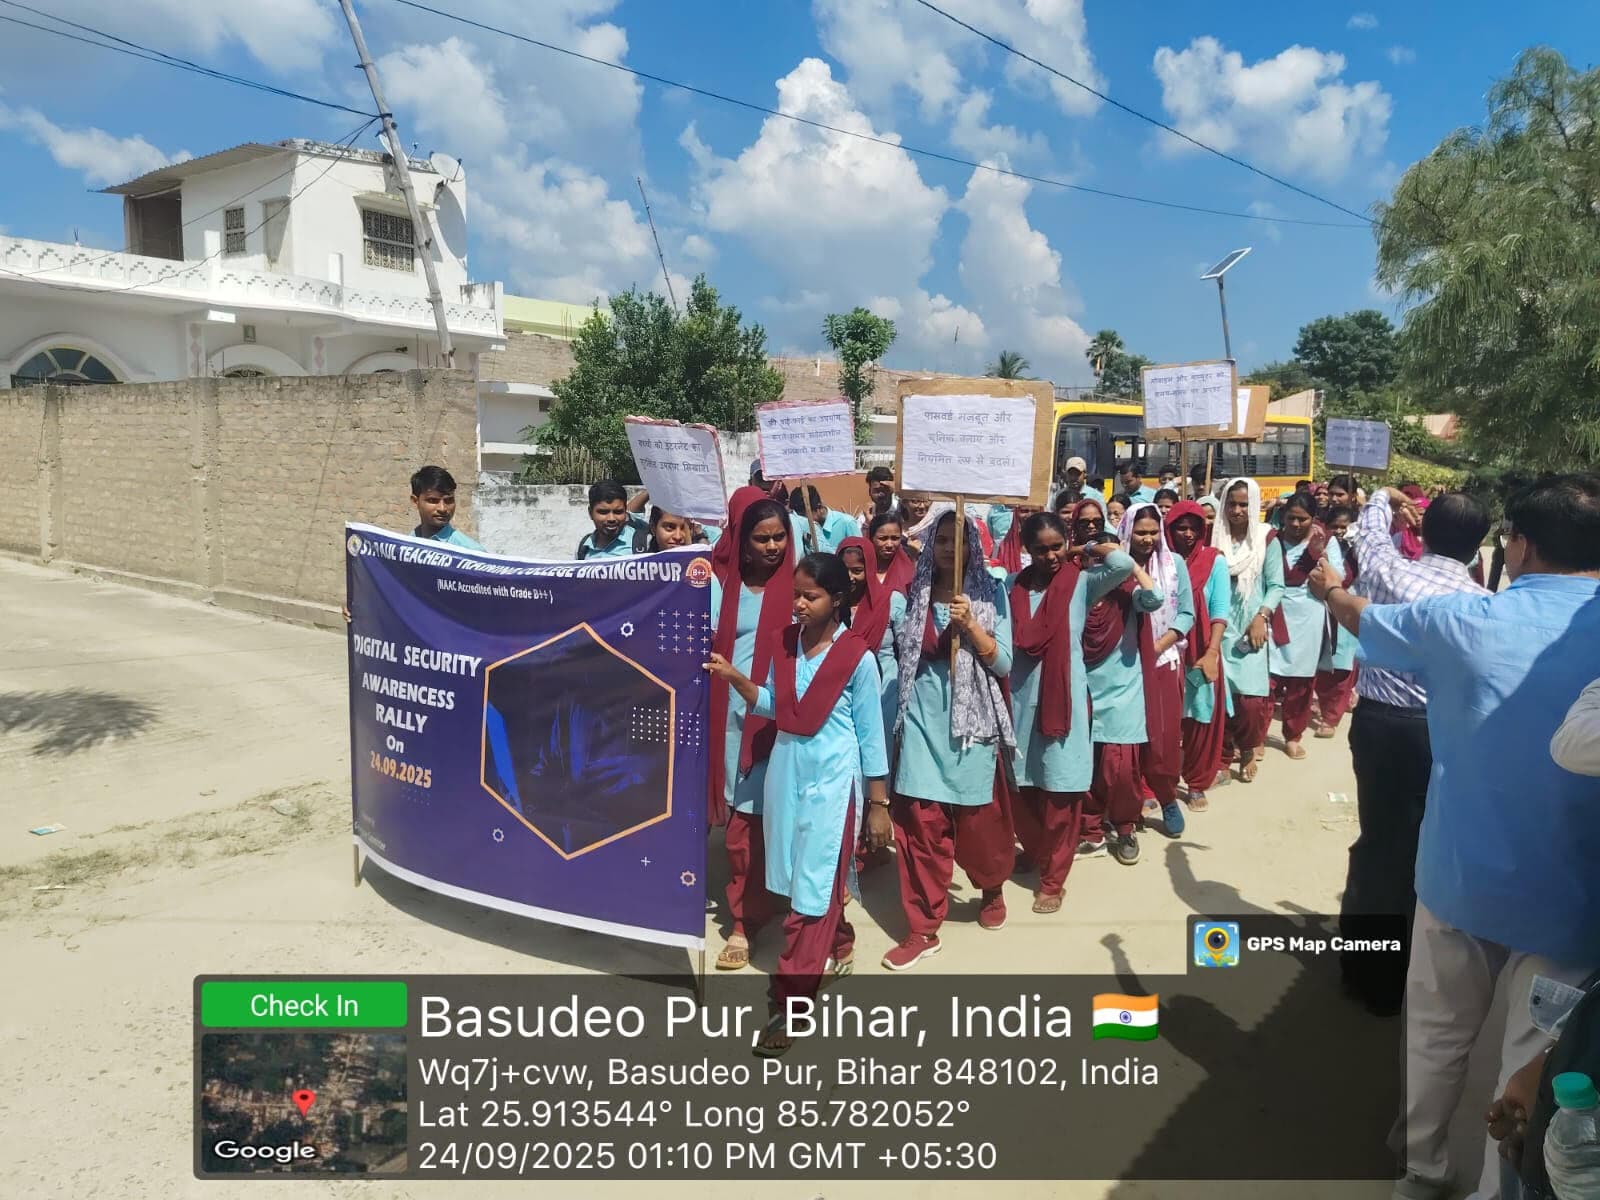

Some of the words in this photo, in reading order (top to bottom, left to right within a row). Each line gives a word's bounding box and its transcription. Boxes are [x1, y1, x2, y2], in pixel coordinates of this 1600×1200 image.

[1176, 374, 1187, 382] और
[924, 410, 953, 422] पासवर्ड
[958, 413, 989, 426] मजबूत
[994, 410, 1012, 423] और
[654, 441, 662, 450] को
[989, 432, 1007, 445] और
[918, 451, 951, 465] नियमित
[957, 455, 970, 465] रूप
[976, 454, 983, 465] से
[577, 562, 682, 582] BIRSINGHPUR
[458, 580, 492, 596] Accredited
[492, 585, 509, 598] with
[510, 587, 533, 599] Grade
[353, 634, 398, 663] DIGITAL
[403, 645, 482, 677] SECURITY
[362, 672, 455, 710] AWARENCESS
[375, 703, 428, 733] RALLY
[386, 735, 404, 753] On
[370, 750, 432, 788] 24.09.2025
